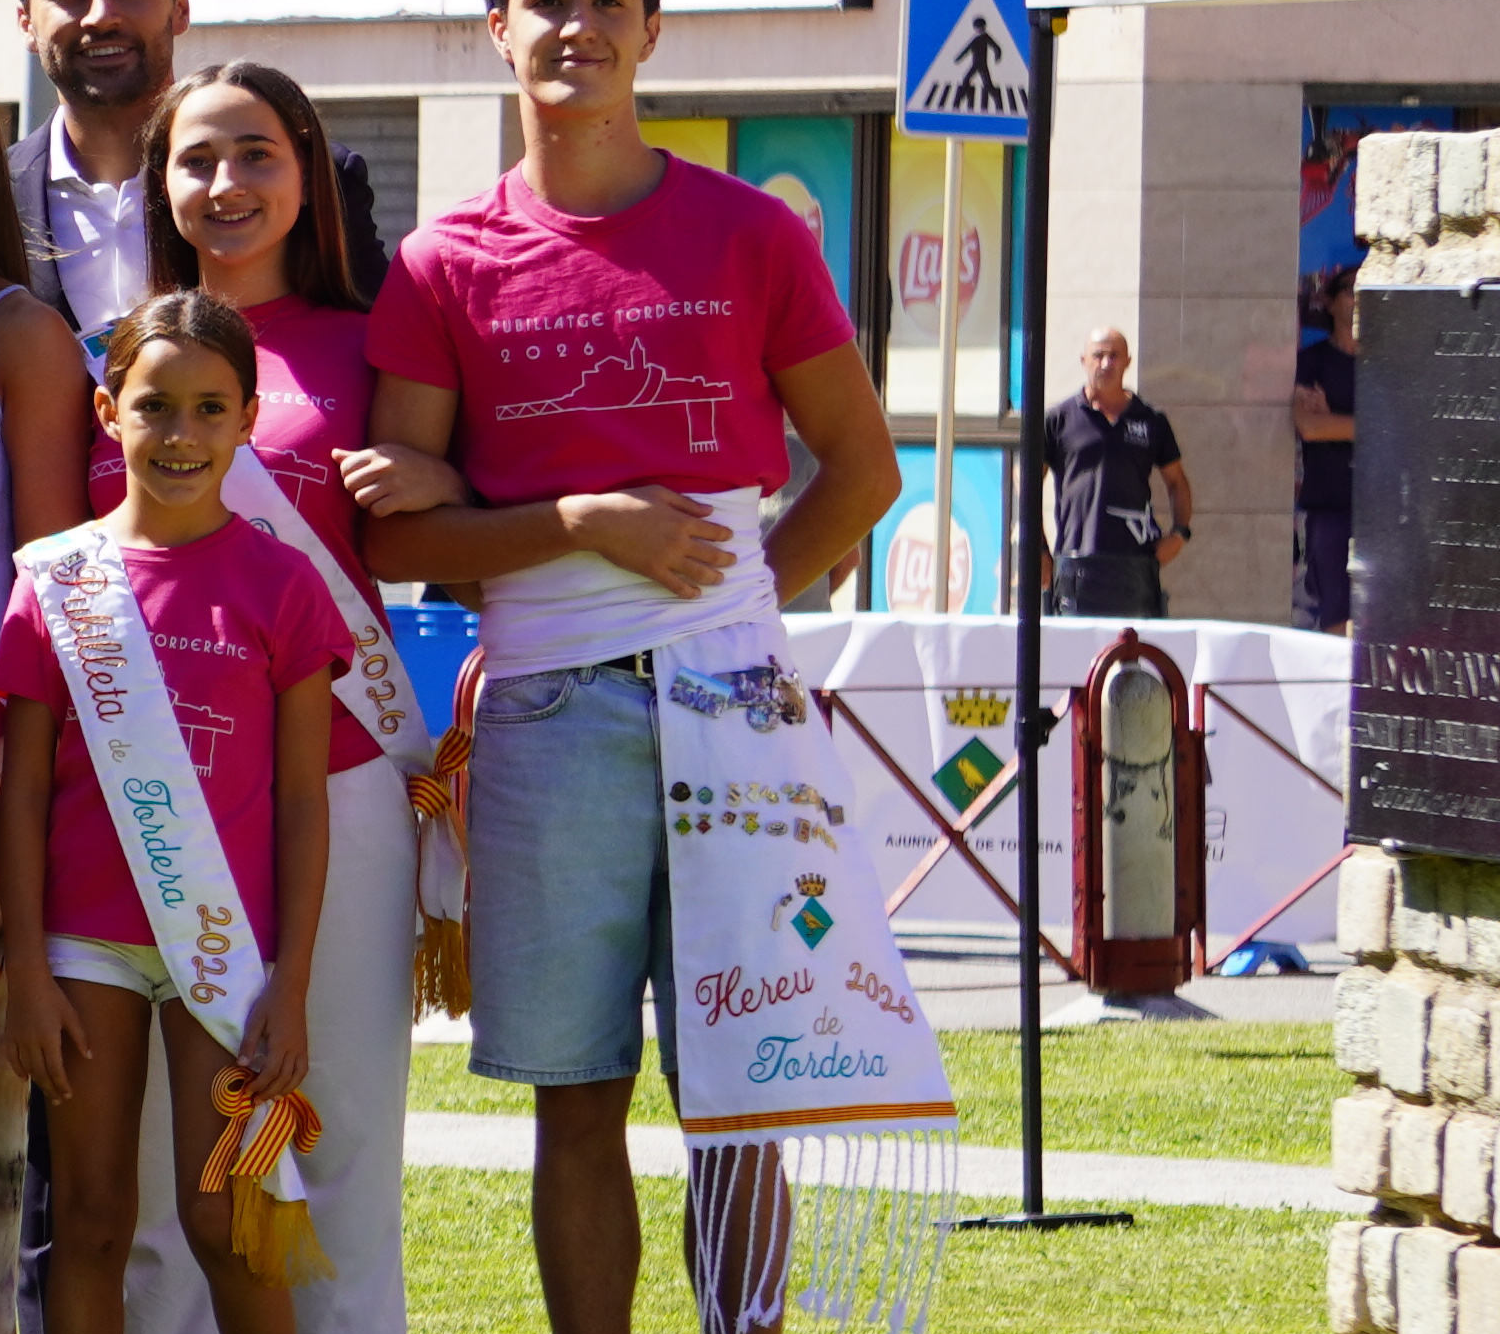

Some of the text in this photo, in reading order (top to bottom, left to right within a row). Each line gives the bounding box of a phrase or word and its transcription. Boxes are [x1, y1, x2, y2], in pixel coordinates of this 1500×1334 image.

[491, 300, 732, 335] PUBILLATGE TORDERENC
[350, 626, 406, 735] 2026
[108, 739, 132, 763] de
[124, 778, 186, 909] Tordera
[976, 839, 994, 851] DE
[189, 904, 233, 1004] 2026
[695, 965, 815, 1027] Hereu
[813, 1005, 843, 1036] de
[845, 962, 914, 1024] 2026
[747, 1034, 888, 1084] Tordera
